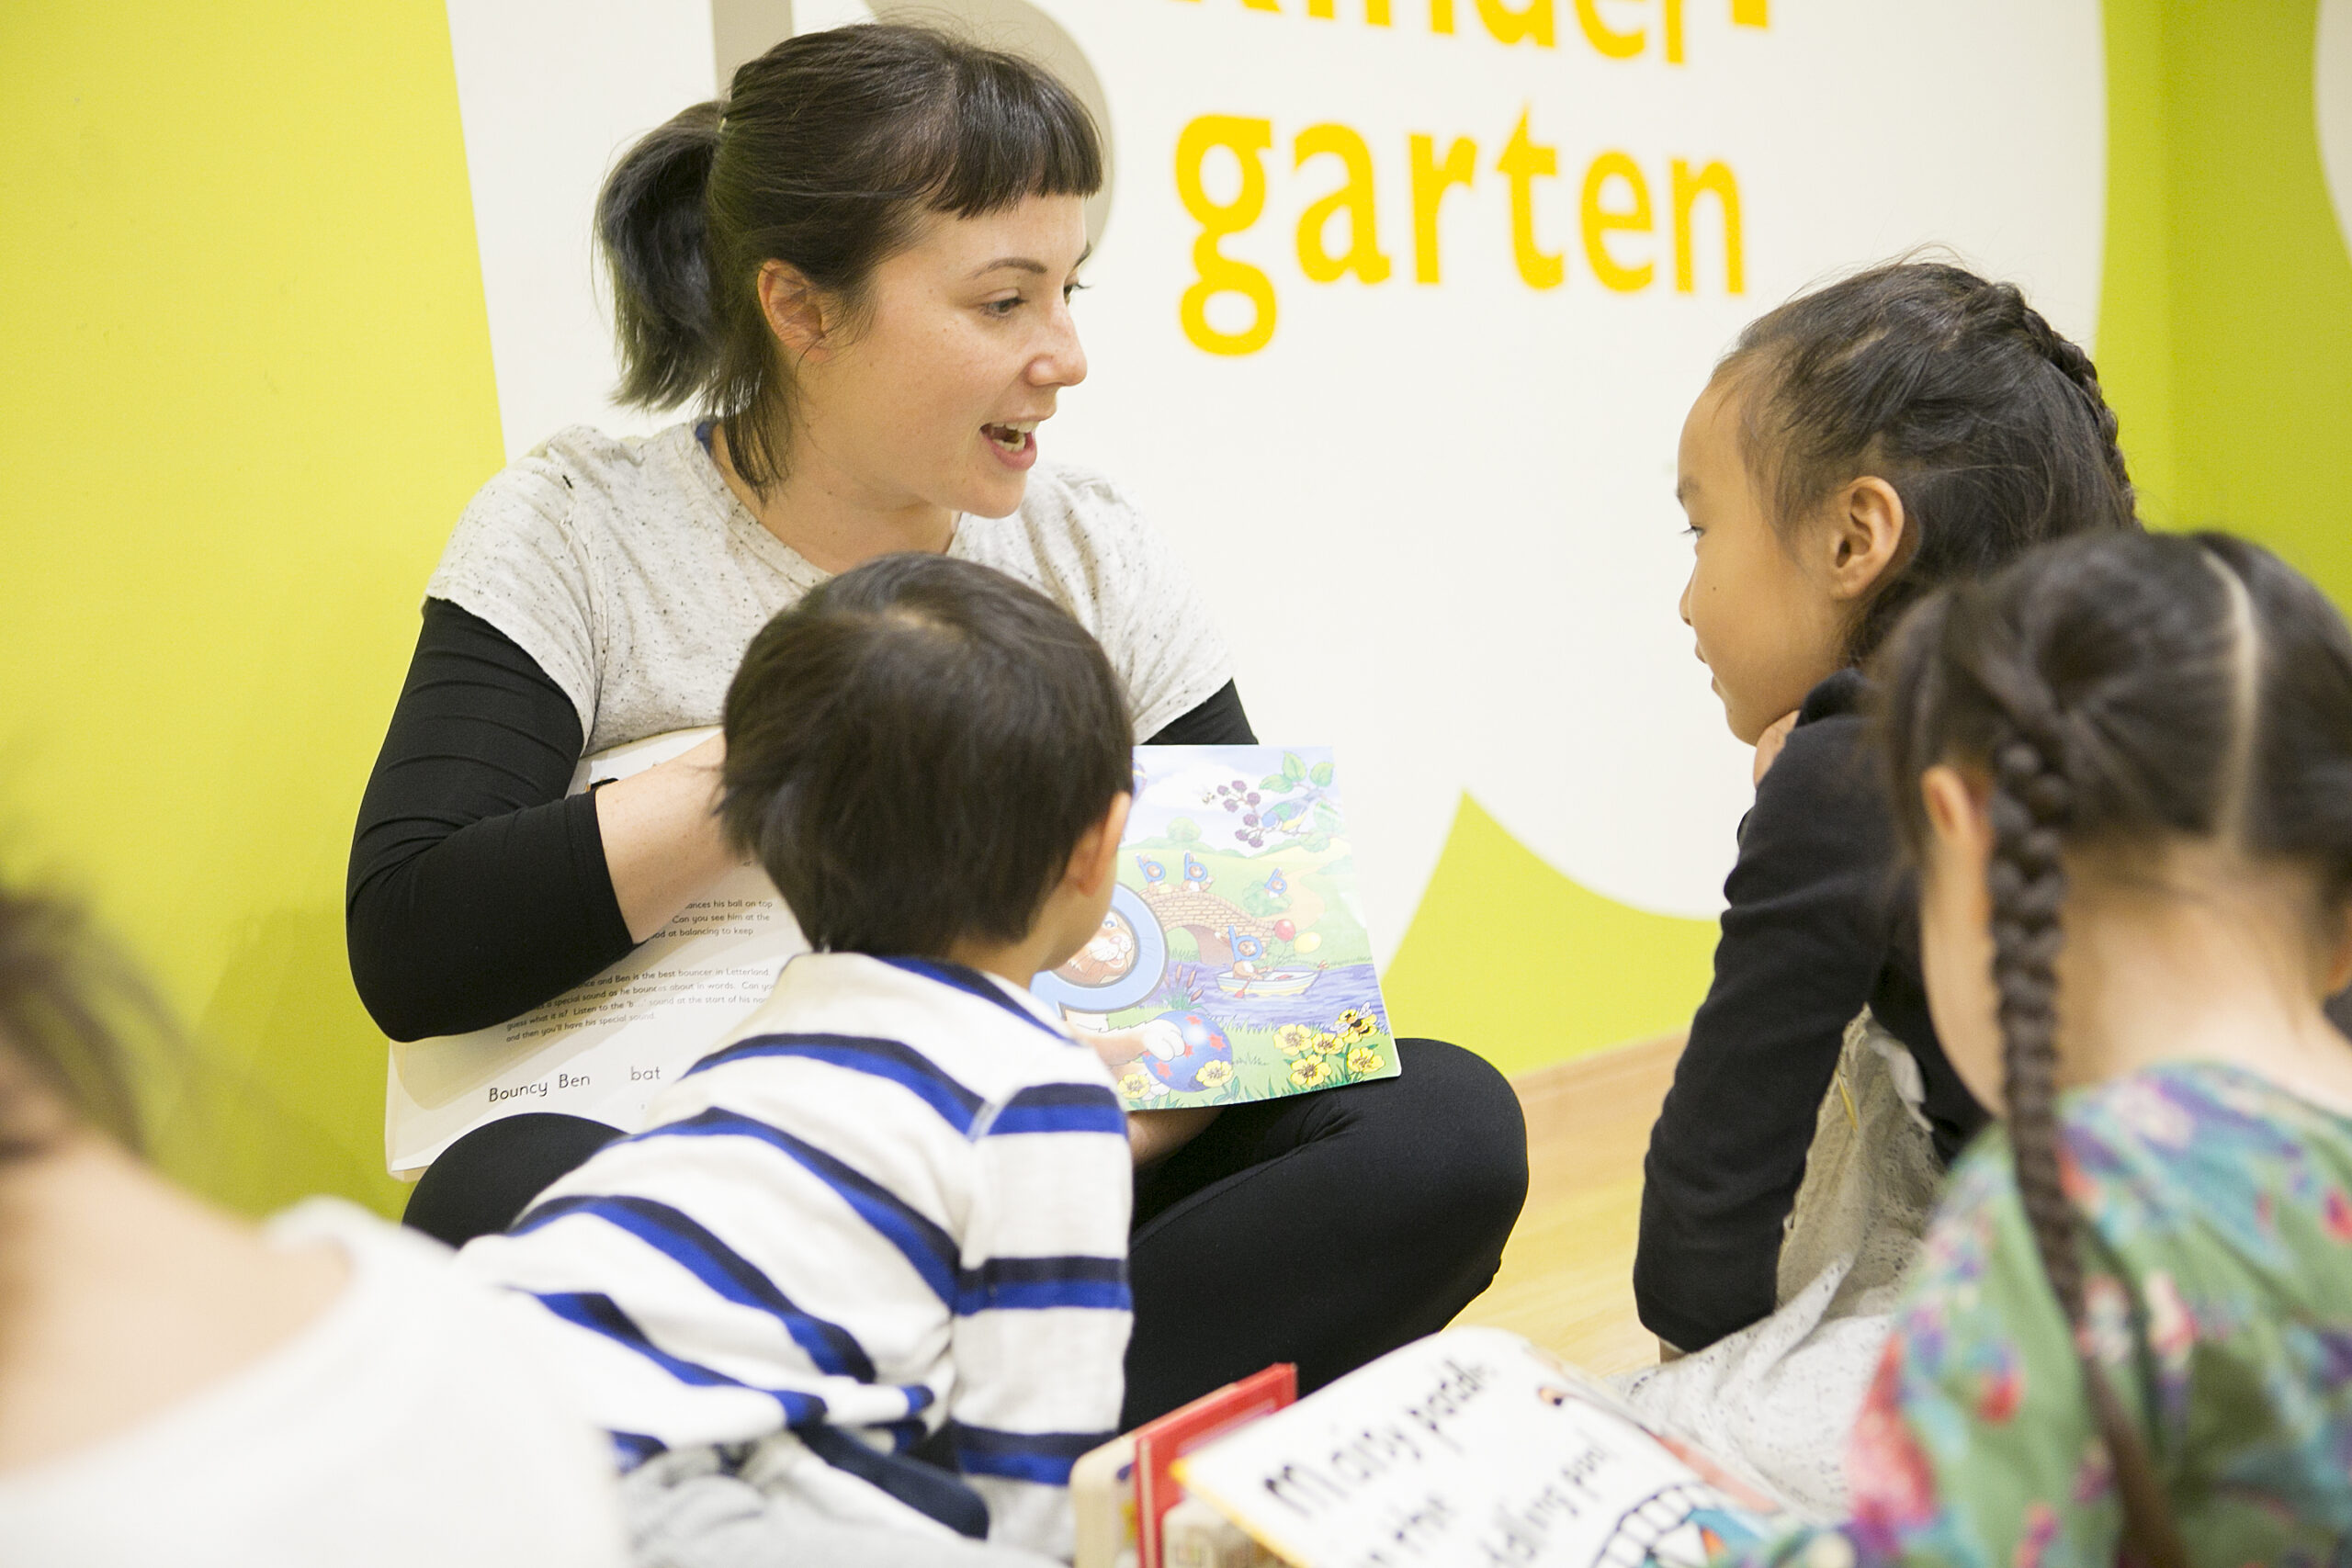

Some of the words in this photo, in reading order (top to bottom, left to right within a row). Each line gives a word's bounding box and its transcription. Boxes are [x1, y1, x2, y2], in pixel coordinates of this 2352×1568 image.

[1174, 101, 1745, 356] garten
[713, 899, 725, 908] his
[727, 899, 742, 908] ball
[759, 899, 773, 909] top
[668, 929, 677, 937] at
[680, 927, 719, 936] balancing
[733, 927, 753, 936] keep
[672, 915, 690, 924] Can
[692, 915, 708, 924] you
[727, 913, 743, 921] him
[745, 913, 754, 921] at
[756, 913, 770, 921] the
[597, 976, 613, 986] and
[615, 974, 630, 984] Ben
[632, 973, 639, 981] is
[641, 972, 656, 980] the
[658, 970, 675, 978] best
[678, 968, 713, 976] bouncer
[555, 996, 581, 1008] special
[582, 990, 606, 1001] sound
[619, 987, 630, 996] he
[632, 985, 667, 995] bounces
[669, 983, 694, 992] about
[741, 981, 759, 989] Can
[761, 984, 775, 993] yo
[506, 1020, 527, 1032] guess
[529, 1014, 548, 1024] what
[550, 1011, 557, 1020] it
[573, 1006, 597, 1017] Listen
[599, 1003, 608, 1011] to
[610, 999, 625, 1010] the
[649, 998, 674, 1007] sound
[677, 997, 686, 1005] at
[688, 995, 703, 1004] the
[705, 995, 725, 1004] start
[728, 994, 737, 1002] of
[739, 994, 751, 1004] his
[505, 1032, 521, 1043] and
[522, 1029, 540, 1039] then
[564, 1021, 583, 1031] have
[585, 1019, 597, 1027] his
[599, 1013, 627, 1026] special
[488, 1081, 548, 1102] Bouncy
[558, 1073, 591, 1089] Ben
[630, 1066, 661, 1081] bat
